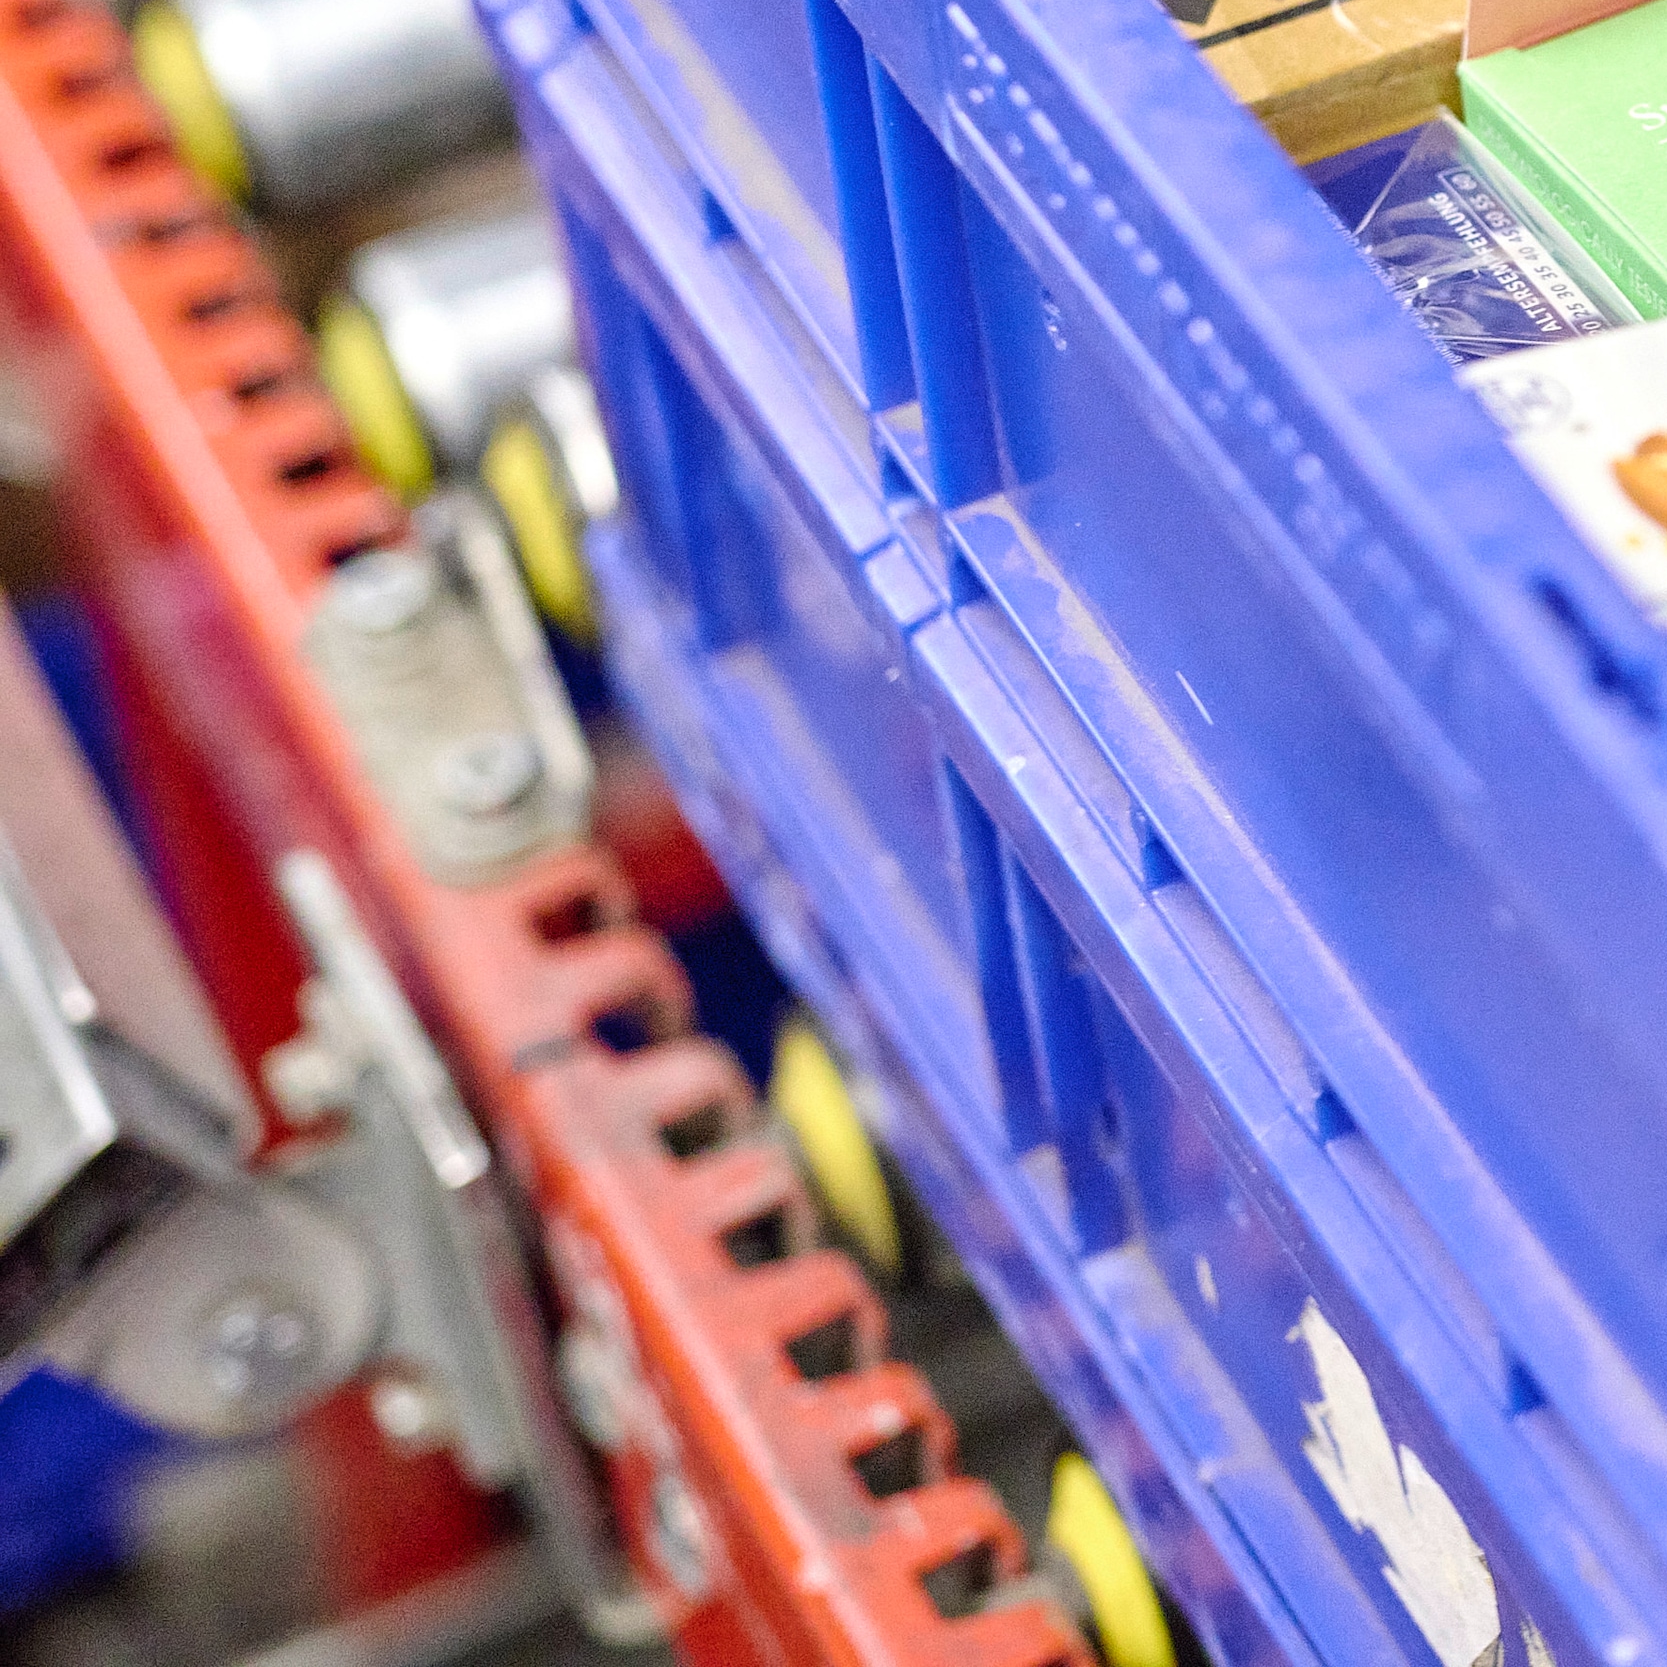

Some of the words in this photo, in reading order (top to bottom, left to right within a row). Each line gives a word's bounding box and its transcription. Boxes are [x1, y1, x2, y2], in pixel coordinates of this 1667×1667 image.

[1518, 247, 1538, 262] 40
[1534, 265, 1558, 281] 35
[1550, 284, 1575, 299] 30
[1567, 303, 1591, 318] 25
